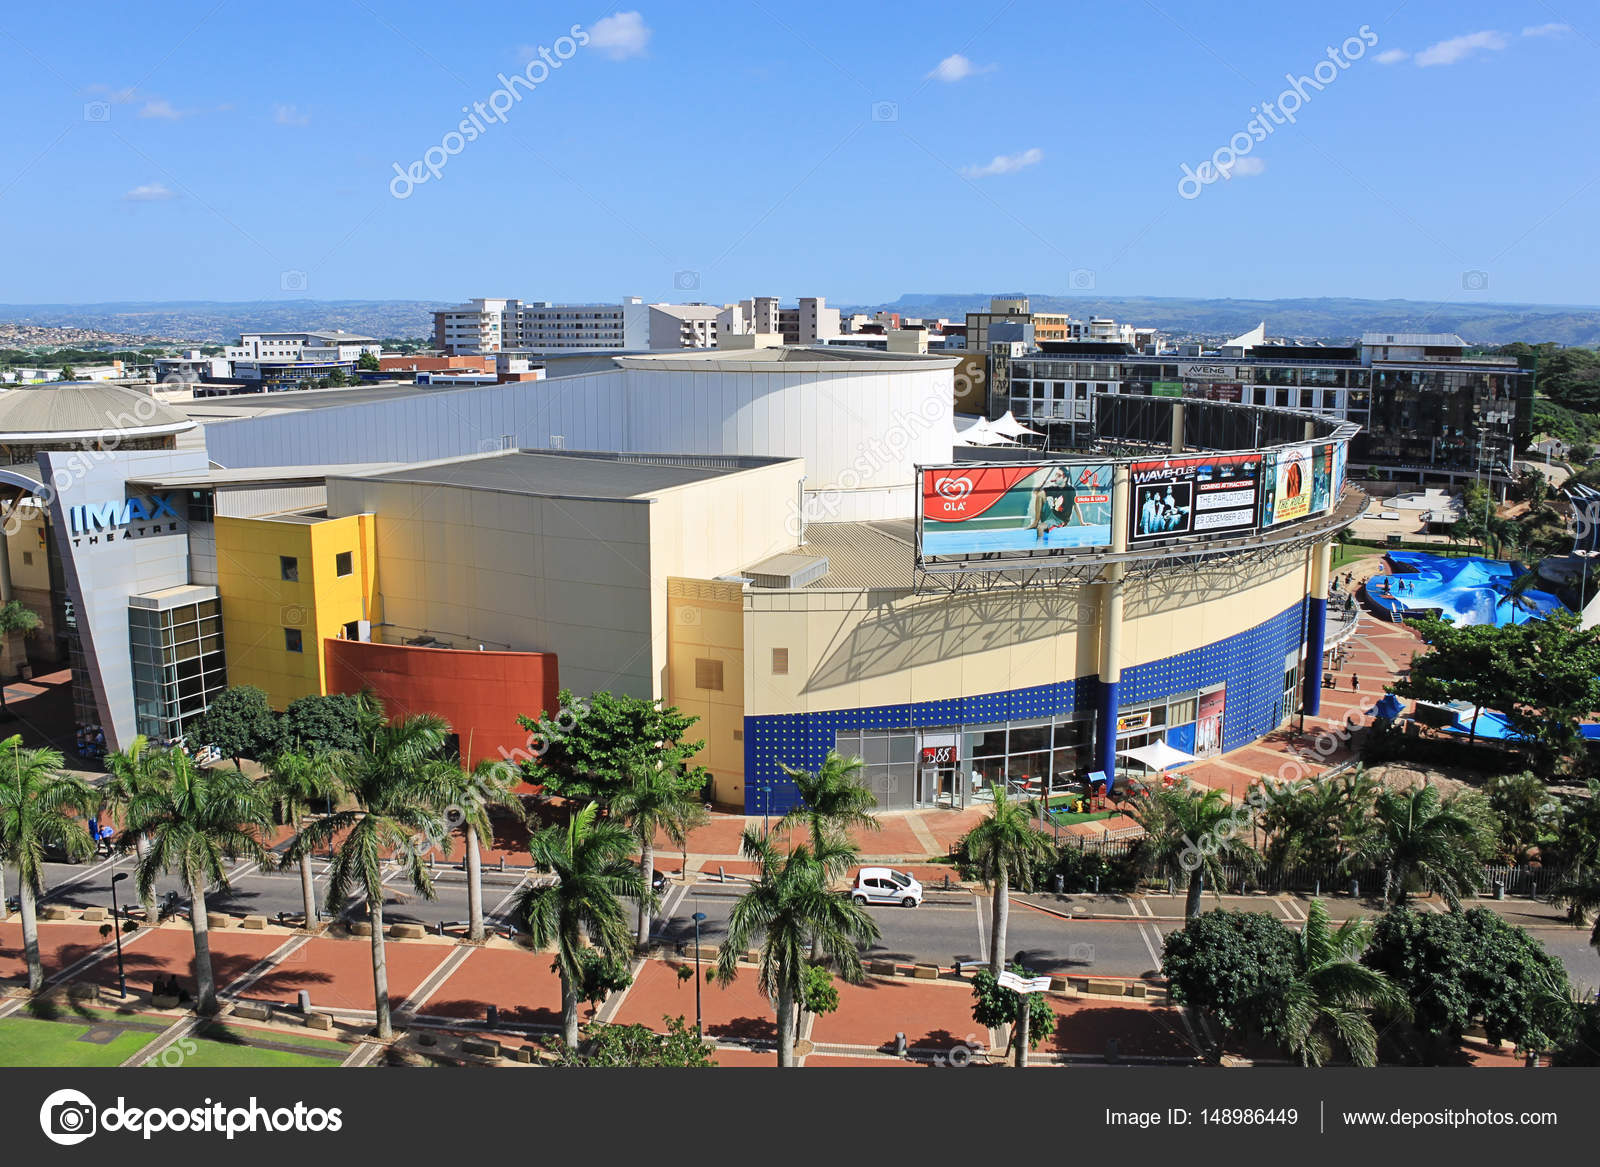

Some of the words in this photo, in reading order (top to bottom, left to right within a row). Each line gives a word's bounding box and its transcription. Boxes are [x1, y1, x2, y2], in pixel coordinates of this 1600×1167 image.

[1189, 366, 1225, 374] AVENG
[70, 494, 177, 534] IMAX
[944, 502, 965, 511] OLA
[73, 522, 177, 547] THEATRE
